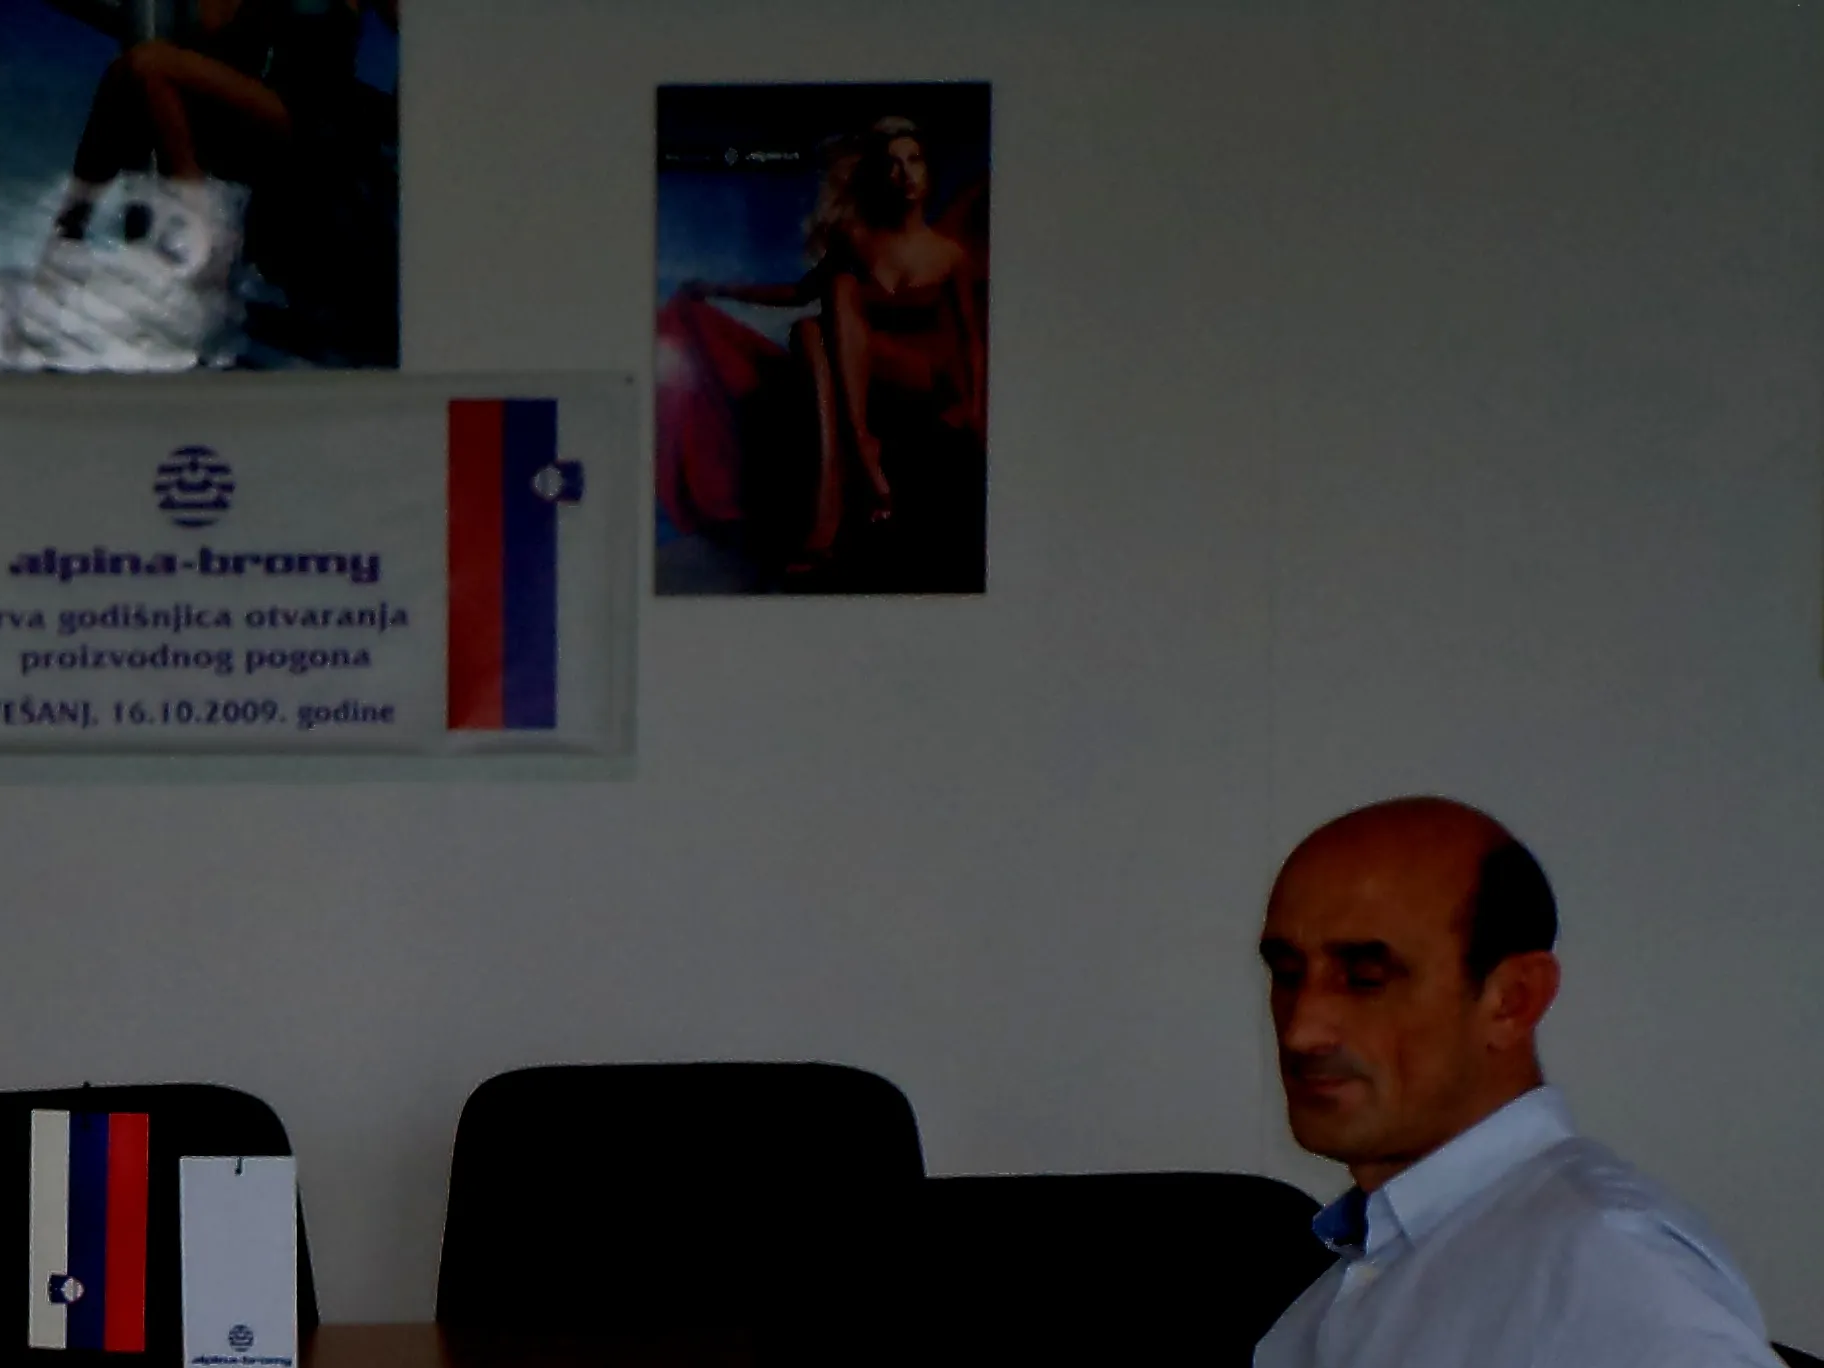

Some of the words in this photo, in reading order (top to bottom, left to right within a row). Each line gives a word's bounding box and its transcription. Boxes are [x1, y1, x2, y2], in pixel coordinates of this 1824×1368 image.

[8, 547, 381, 583] alpina-bromy
[57, 603, 232, 636] godišnjica
[245, 602, 409, 634] otvaranja
[22, 644, 234, 676] proizvodnog
[245, 650, 371, 675] pogona
[297, 700, 395, 731] godine
